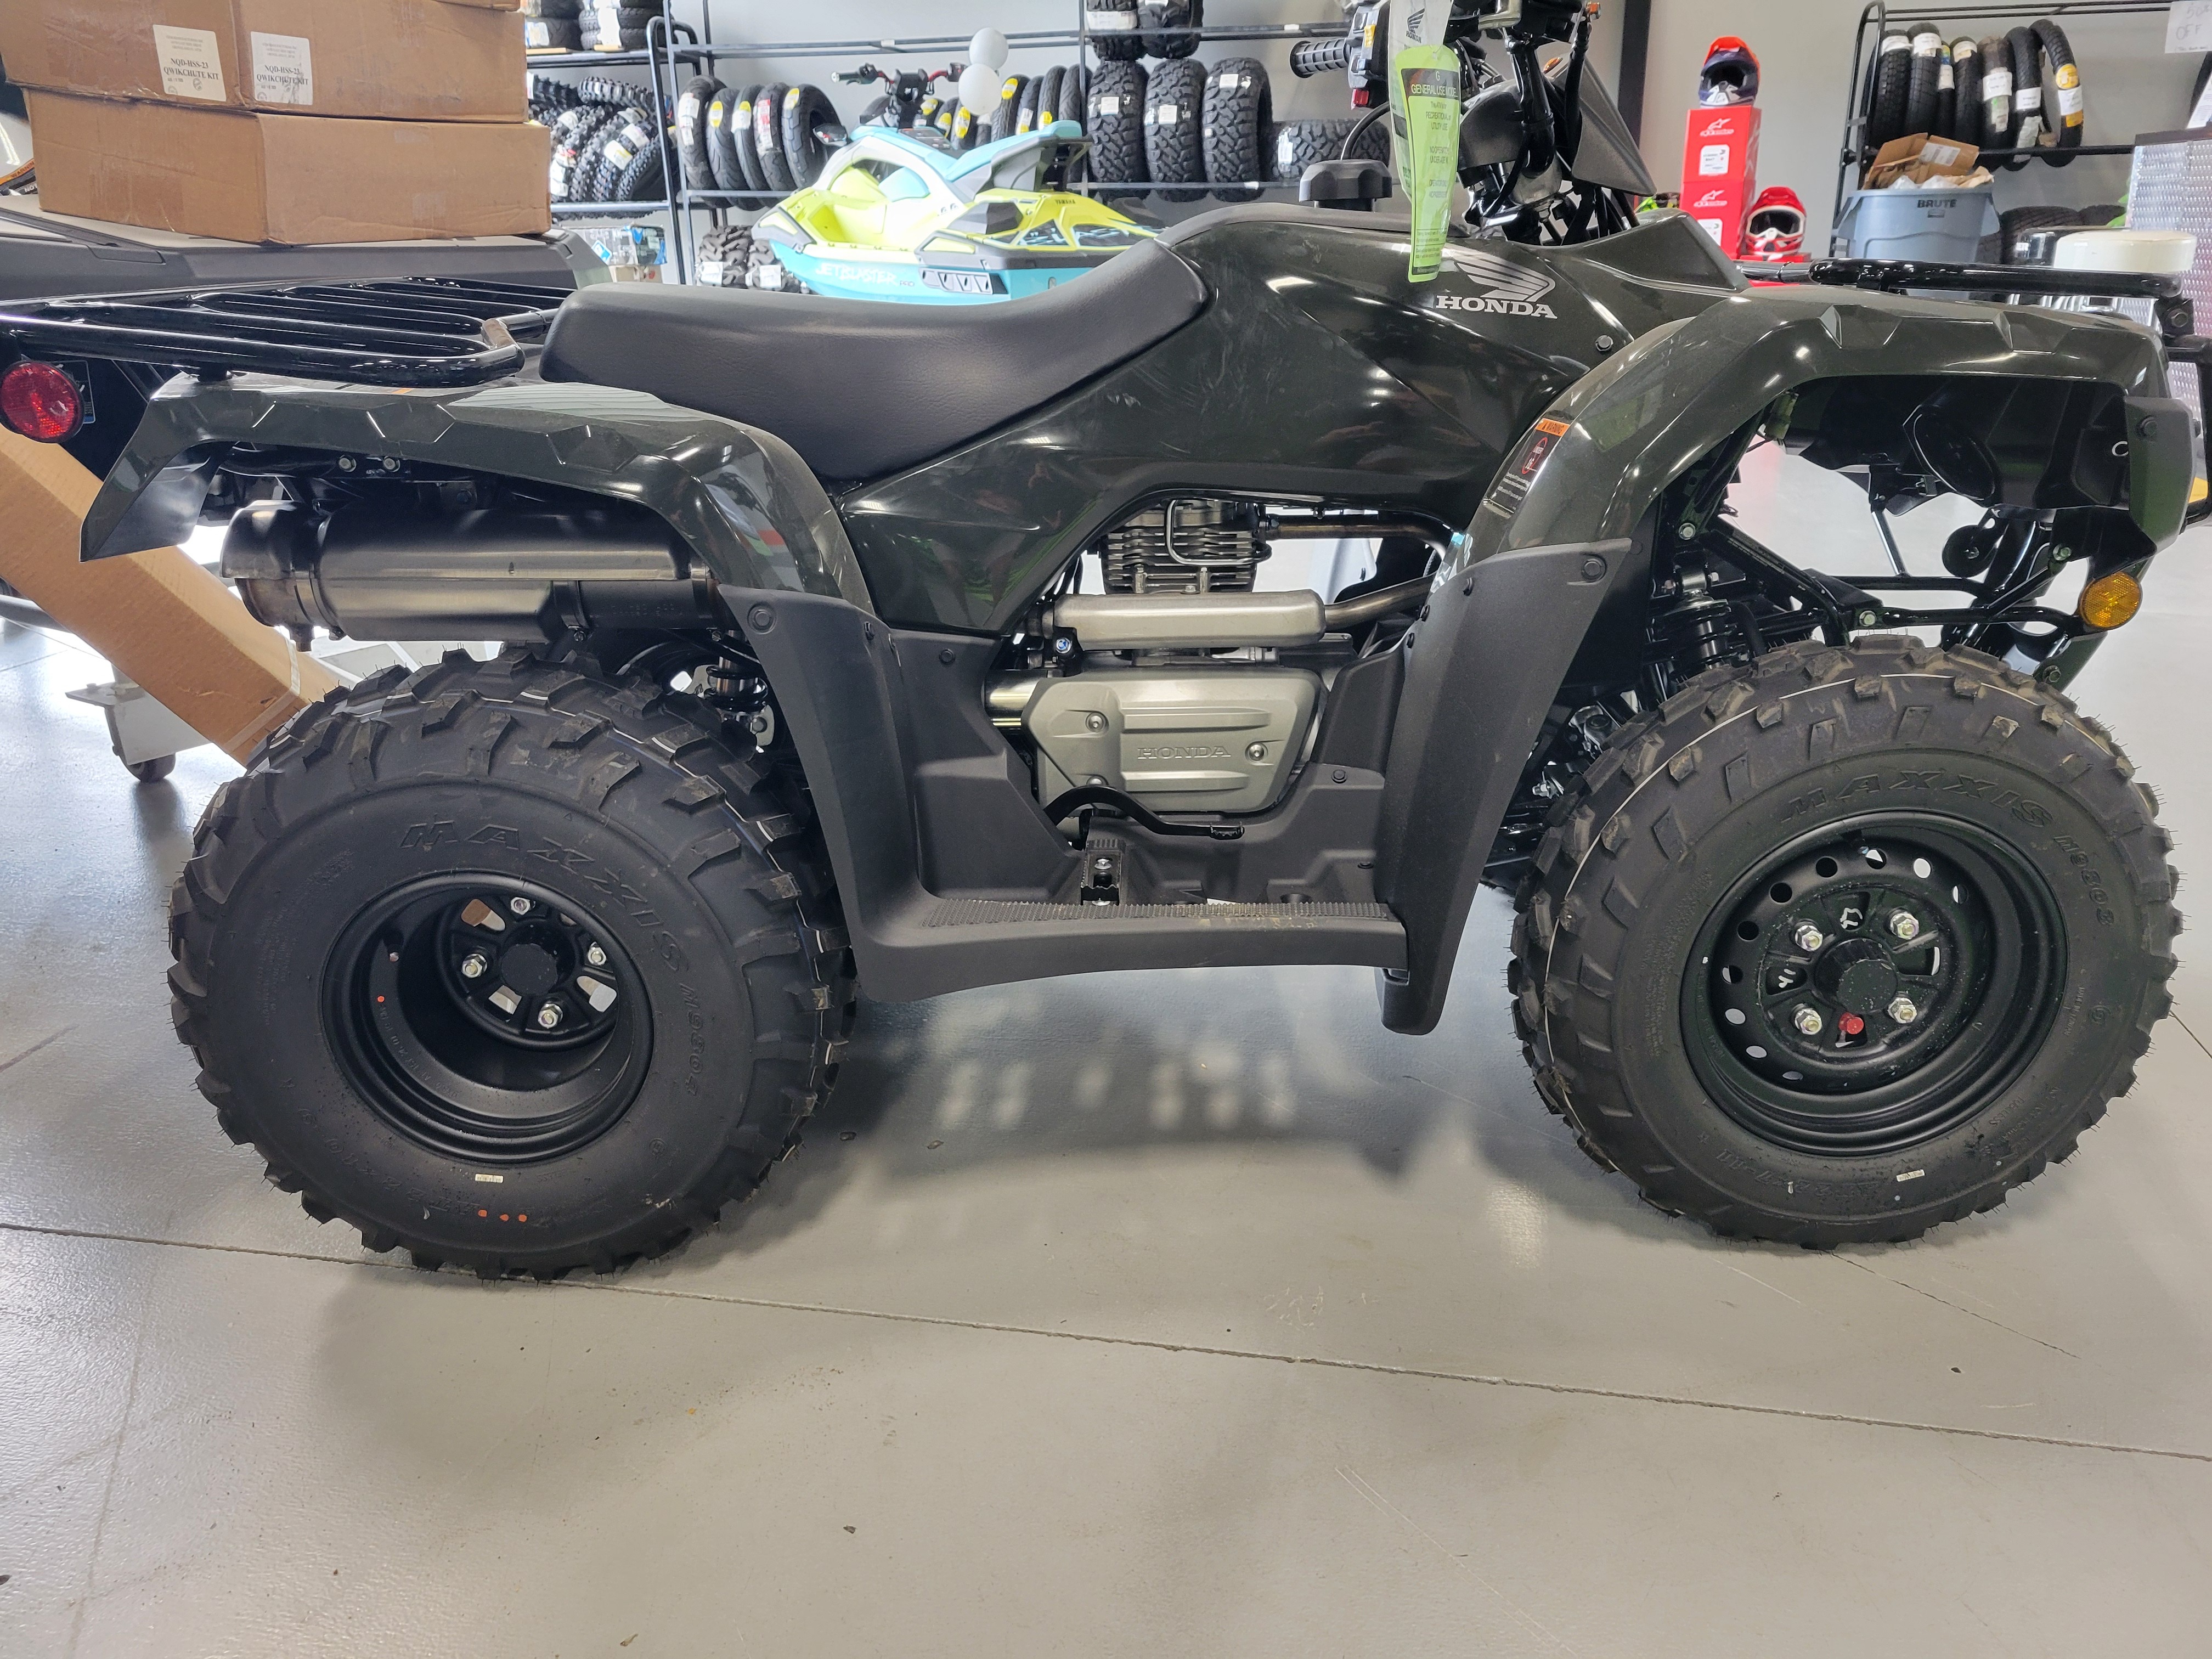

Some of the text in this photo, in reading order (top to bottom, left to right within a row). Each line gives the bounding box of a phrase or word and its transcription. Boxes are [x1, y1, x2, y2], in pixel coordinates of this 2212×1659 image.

[1406, 30, 1422, 43] HONDA
[2176, 24, 2202, 40] OFF
[171, 58, 208, 69] NQD-HSS-23
[264, 64, 300, 75] NQD-HSS-23
[163, 66, 219, 80] QWIKCHUTE KIT
[256, 74, 296, 84] QWIKCHUTE
[1411, 83, 1436, 94] GENERAL
[1437, 85, 1445, 95] USE
[1917, 199, 1957, 208] BRUTE
[1435, 295, 1558, 320] HONDA
[1137, 746, 1232, 760] HONDA
[1780, 769, 2115, 927] MAXXIS M9803
[399, 820, 690, 972] MAXXIS
